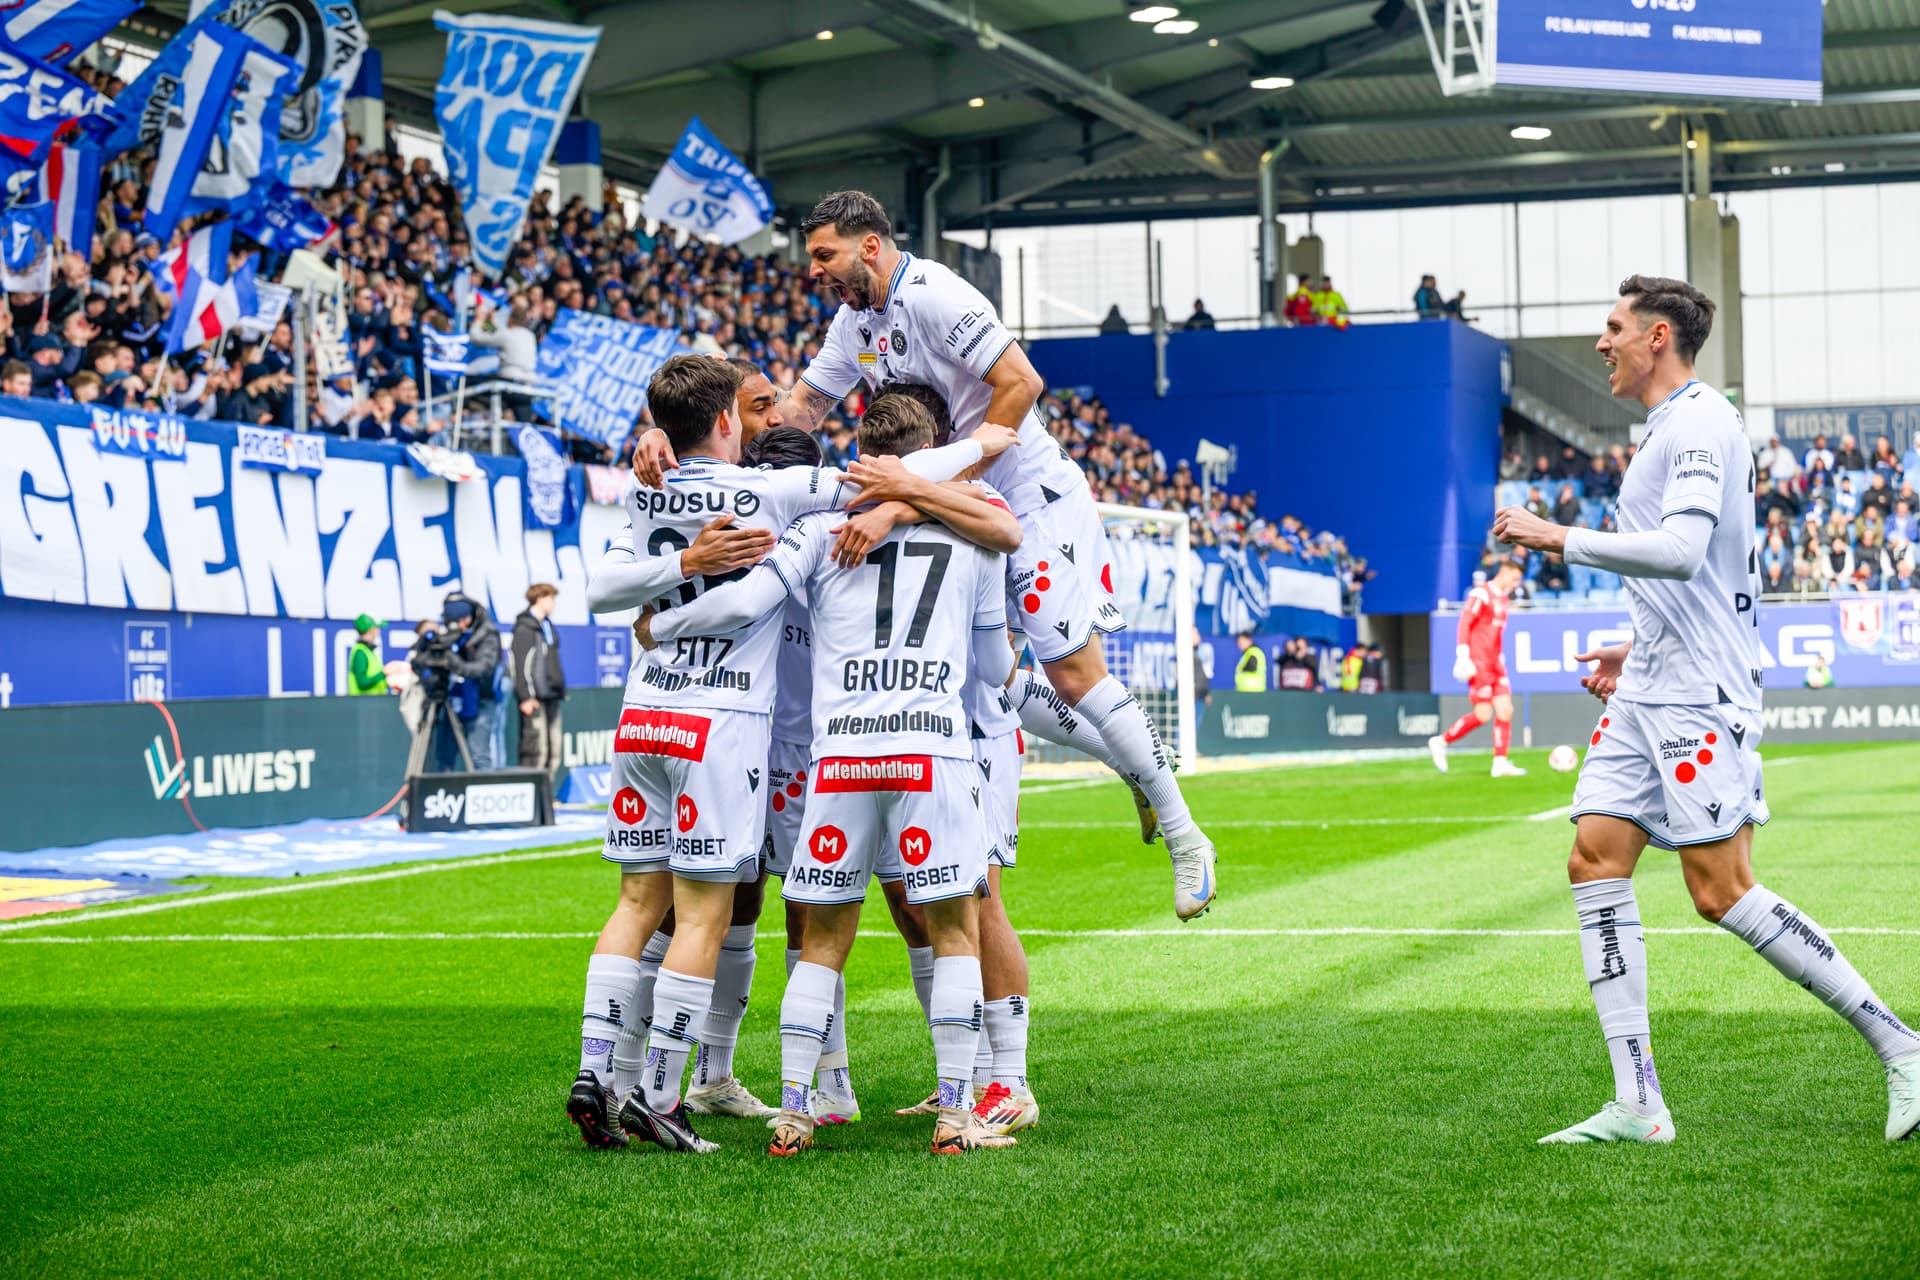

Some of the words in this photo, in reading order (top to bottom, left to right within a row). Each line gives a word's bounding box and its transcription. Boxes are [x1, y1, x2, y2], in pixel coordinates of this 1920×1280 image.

[635, 490, 725, 520] spusu
[866, 540, 953, 650] 17
[843, 658, 950, 694] GRUBER
[1832, 705, 1872, 728] AM
[194, 749, 315, 798] LIWEST
[424, 788, 464, 823] sky
[471, 790, 528, 818] sport
[622, 797, 639, 815] M
[678, 804, 690, 822] M
[818, 835, 838, 855] M
[905, 836, 924, 856] M
